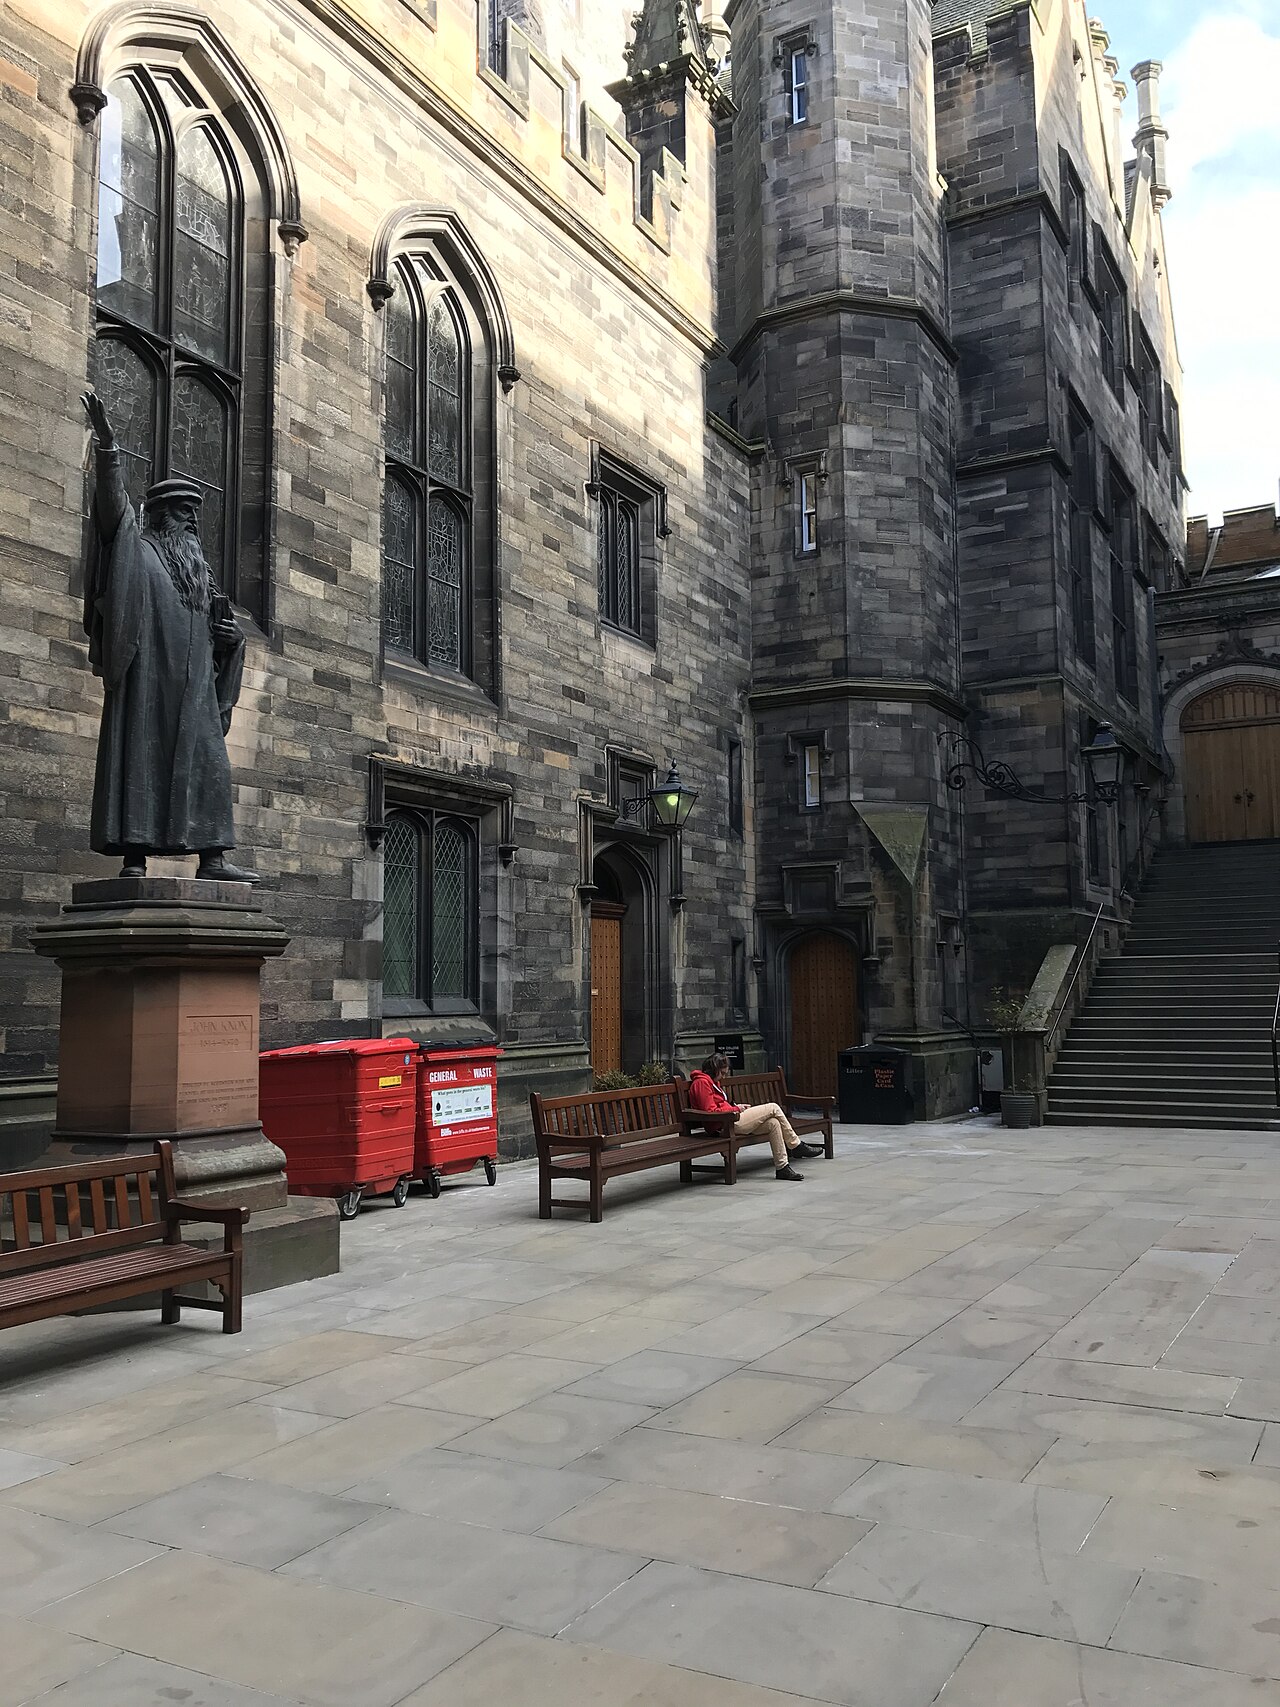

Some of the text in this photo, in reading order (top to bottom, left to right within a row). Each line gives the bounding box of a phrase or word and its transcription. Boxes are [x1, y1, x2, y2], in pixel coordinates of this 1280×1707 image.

[189, 1021, 218, 1033] JOHN
[429, 1067, 492, 1082] GENERAL WASTE
